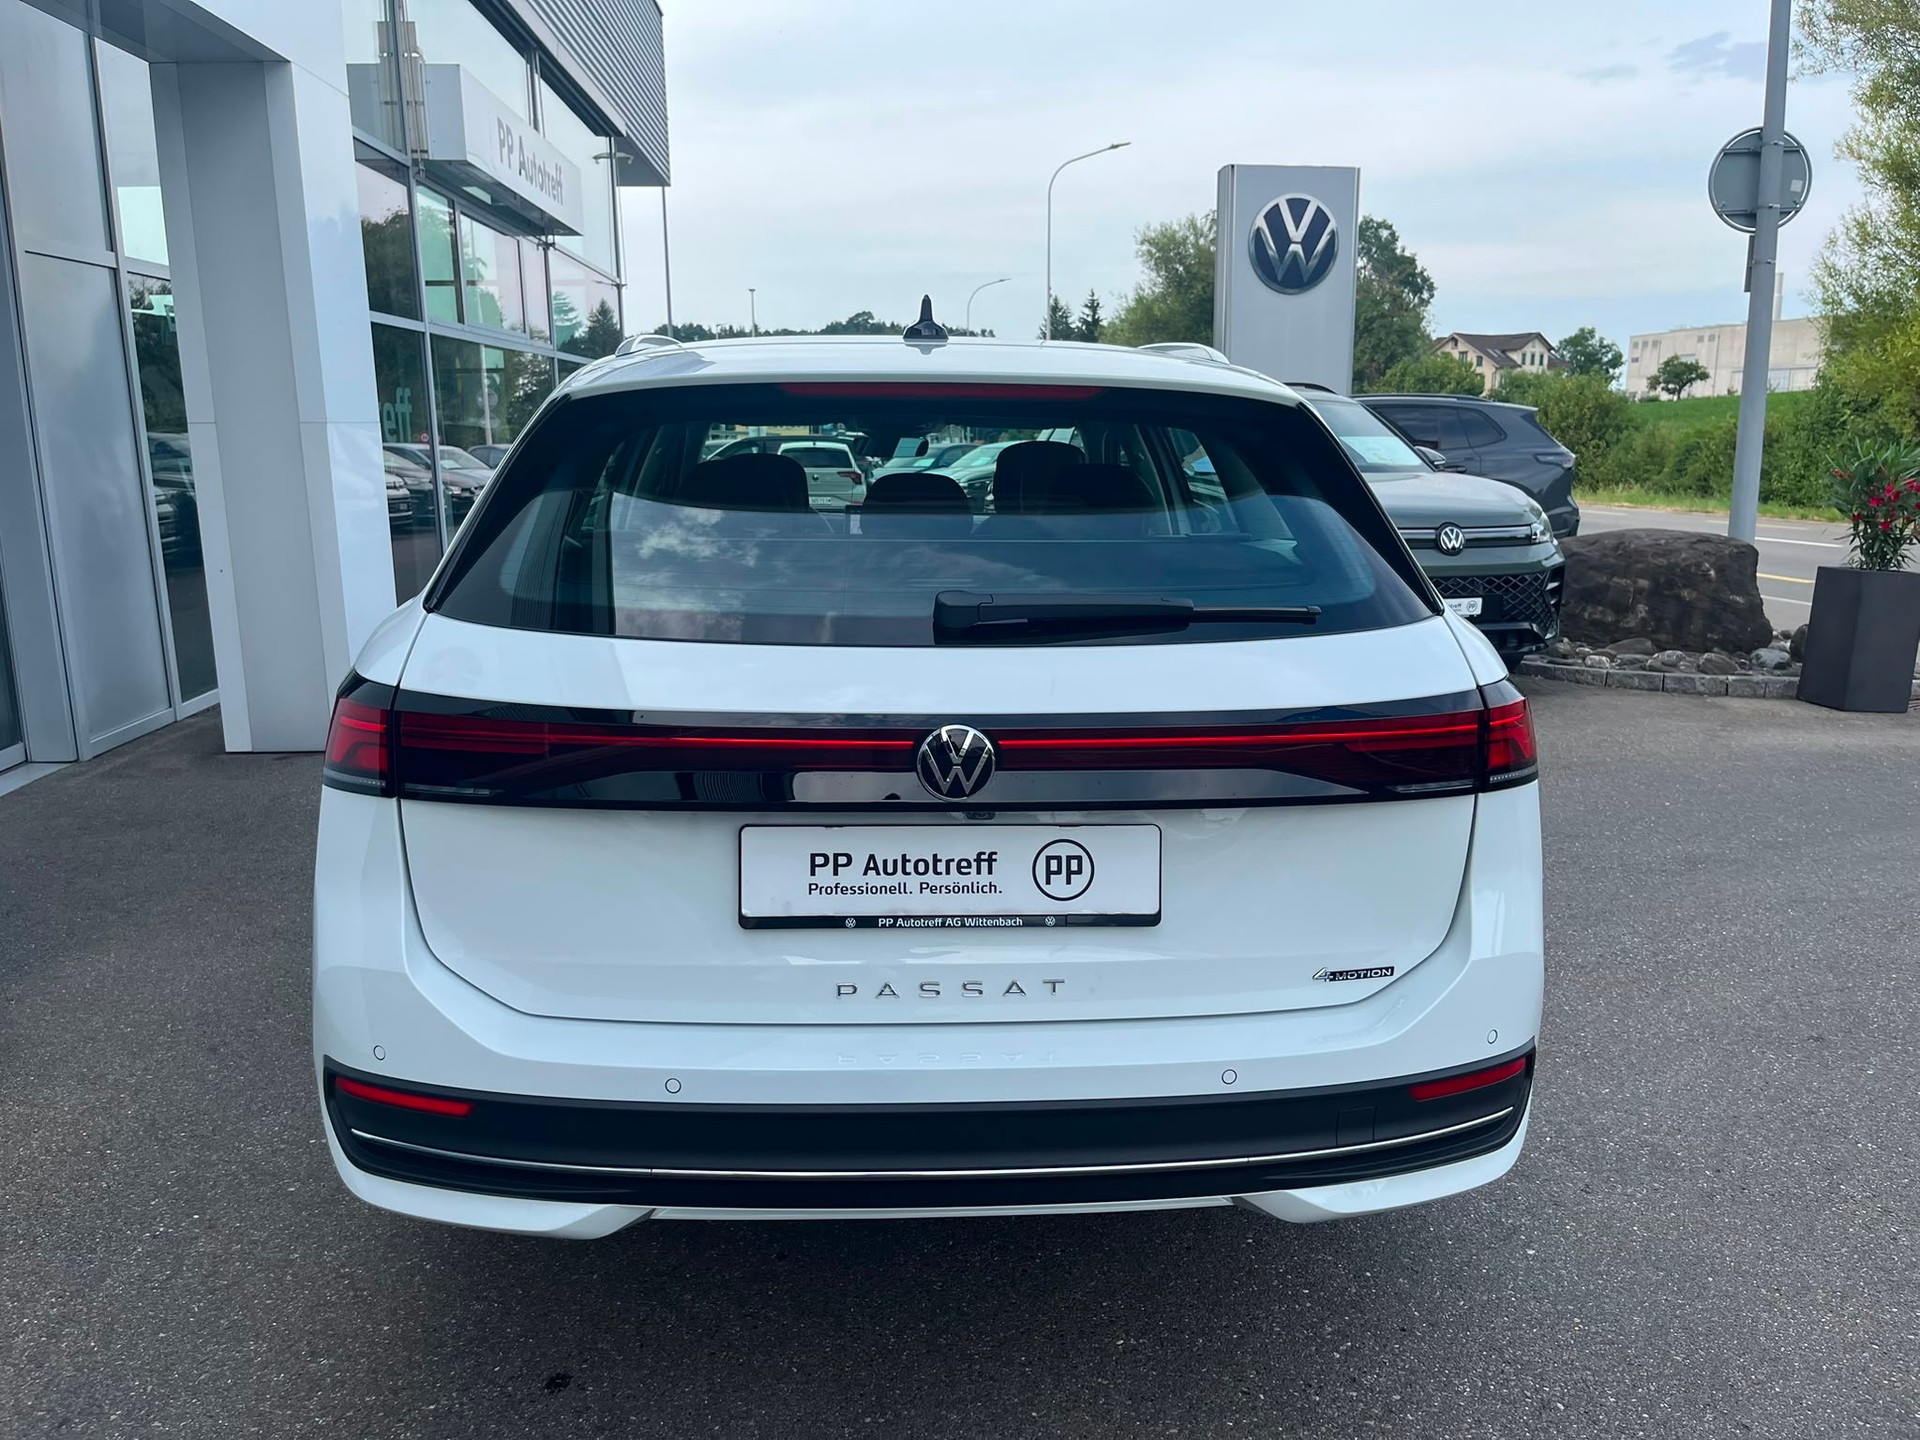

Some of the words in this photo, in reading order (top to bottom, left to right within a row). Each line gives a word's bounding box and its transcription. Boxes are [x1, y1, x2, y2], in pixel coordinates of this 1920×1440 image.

[497, 116, 514, 170] PP
[519, 135, 563, 206] Autotreff
[1248, 193, 1339, 295] VW
[917, 724, 996, 801] VW
[809, 852, 853, 877] PP
[862, 851, 998, 876] Autotreff
[1044, 854, 1084, 886] PP
[808, 882, 913, 896] Professionell.
[919, 881, 1003, 895] Persönlich.
[878, 918, 894, 928] PP
[896, 917, 943, 928] Autotreff
[944, 917, 962, 927] AG
[964, 916, 1023, 927] Wittenbach
[836, 978, 1066, 999] PASSAT
